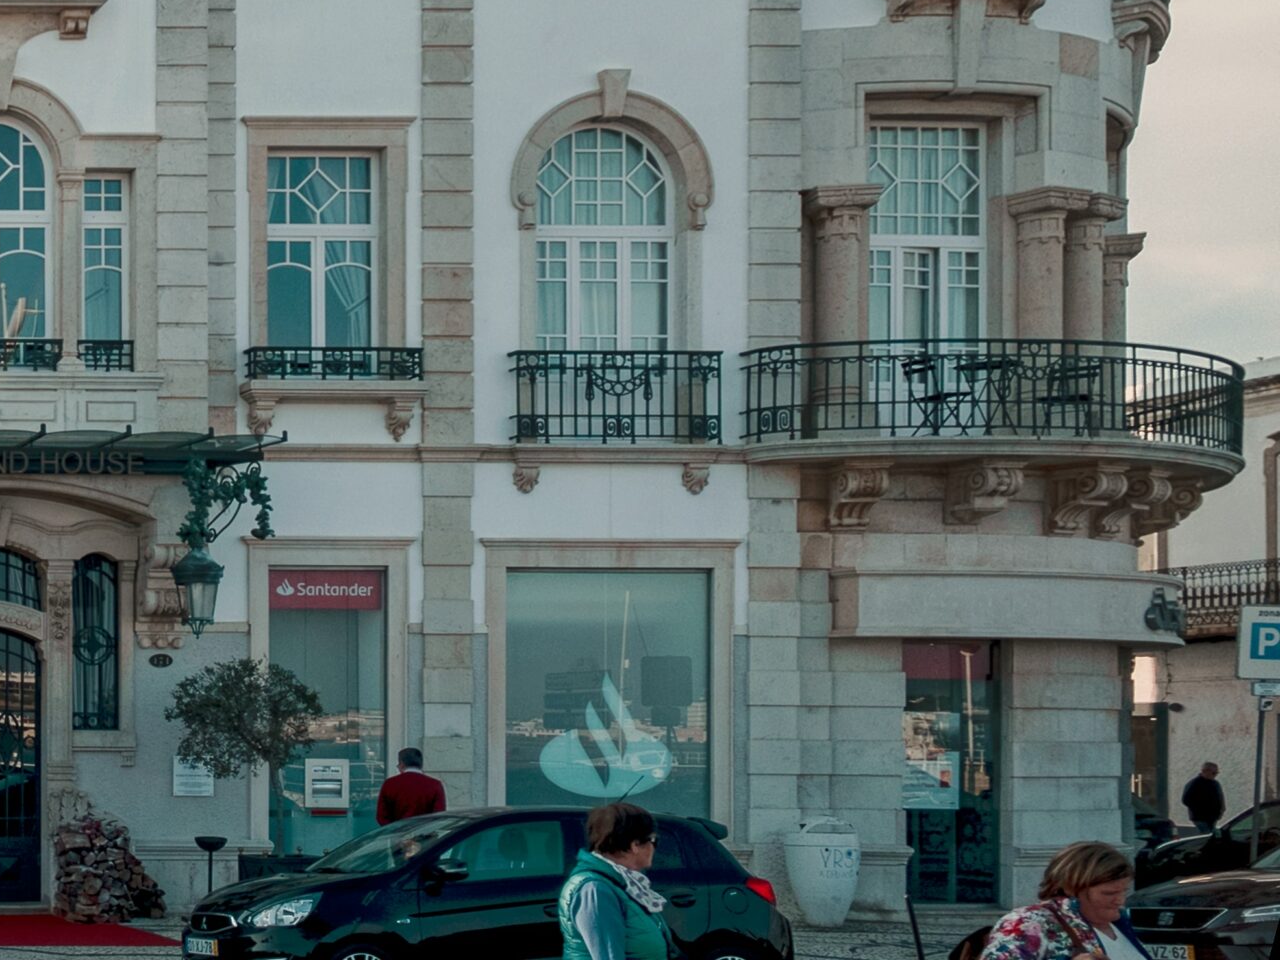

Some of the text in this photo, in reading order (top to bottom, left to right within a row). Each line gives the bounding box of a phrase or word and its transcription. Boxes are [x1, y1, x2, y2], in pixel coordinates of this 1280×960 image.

[40, 450, 145, 475] HOUSE
[297, 582, 373, 597] Santander
[1258, 627, 1280, 656] P
